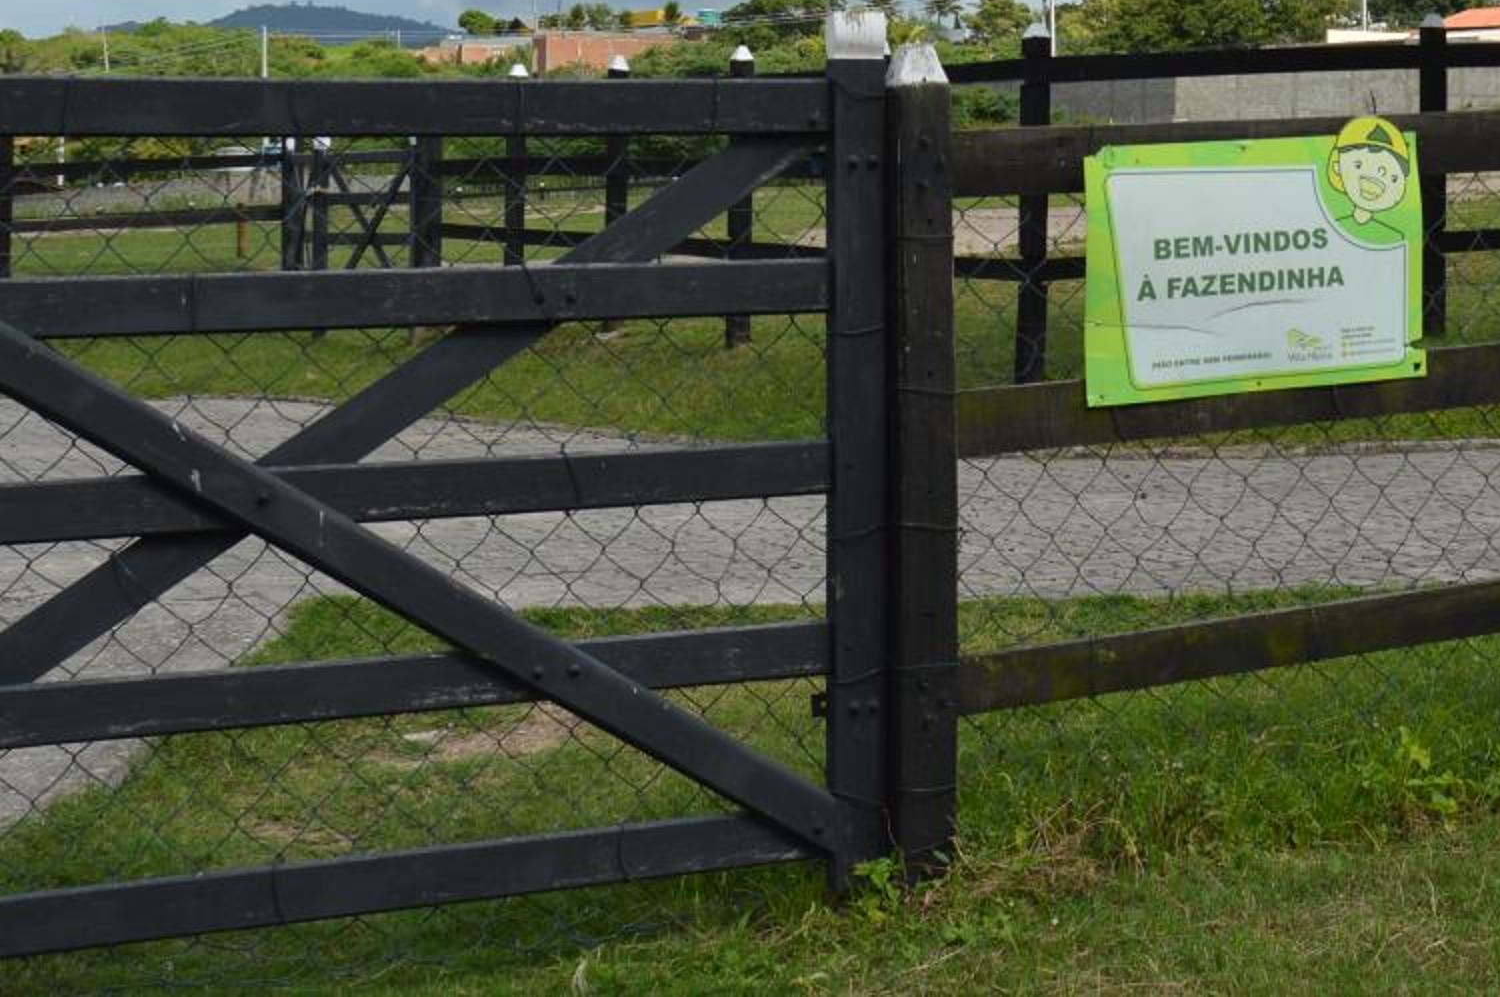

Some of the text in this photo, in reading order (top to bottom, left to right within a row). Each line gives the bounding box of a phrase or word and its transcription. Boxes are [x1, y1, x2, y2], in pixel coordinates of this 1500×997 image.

[1153, 228, 1329, 260] BEM-VINDOS
[1136, 266, 1345, 301] À FAZENDINHA
